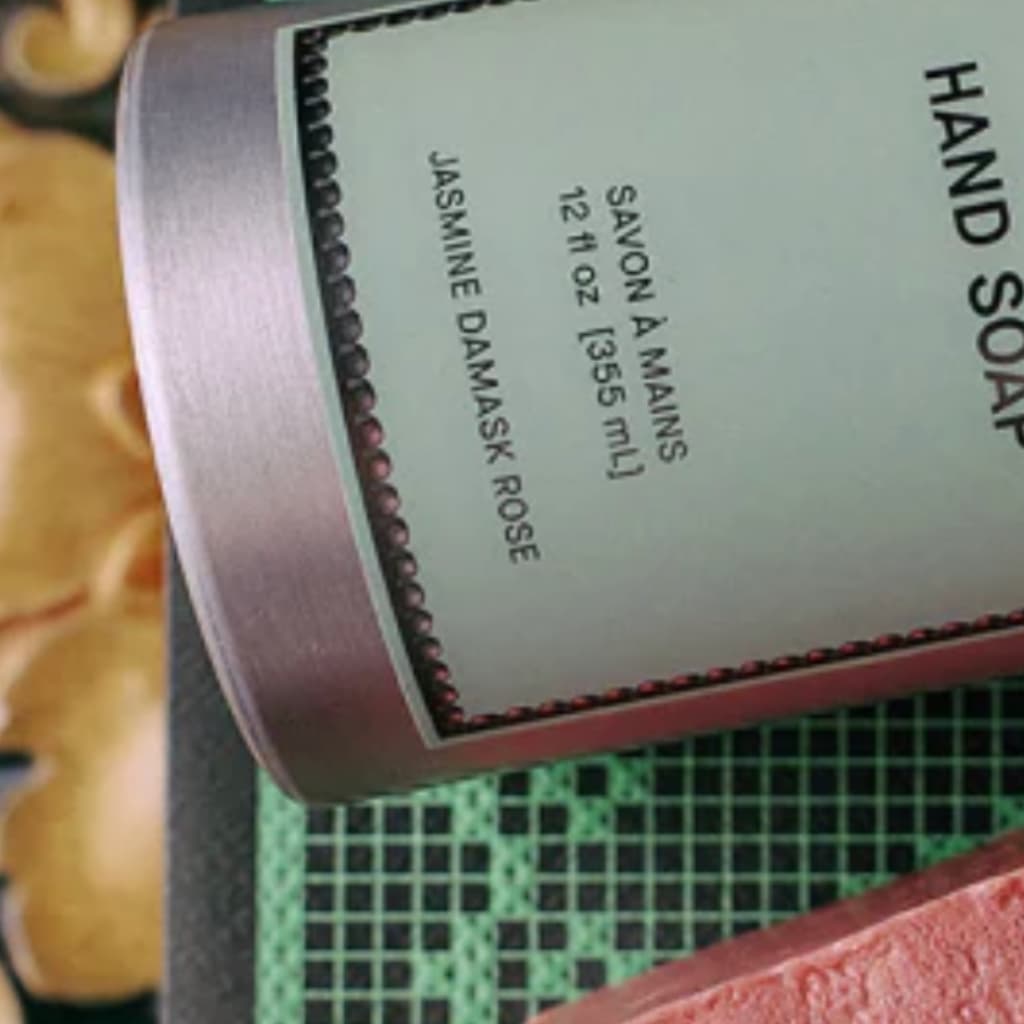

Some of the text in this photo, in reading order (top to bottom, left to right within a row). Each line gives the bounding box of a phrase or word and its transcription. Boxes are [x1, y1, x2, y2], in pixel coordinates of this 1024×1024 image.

[923, 61, 1012, 247] HAND
[559, 185, 588, 225] 12
[571, 264, 600, 307] oz
[605, 184, 656, 304] SAVON
[638, 346, 689, 464] MAINS
[428, 150, 541, 565] JASMINE DAMASK ROSE
[577, 327, 626, 407] [355
[603, 416, 646, 480] mL]
